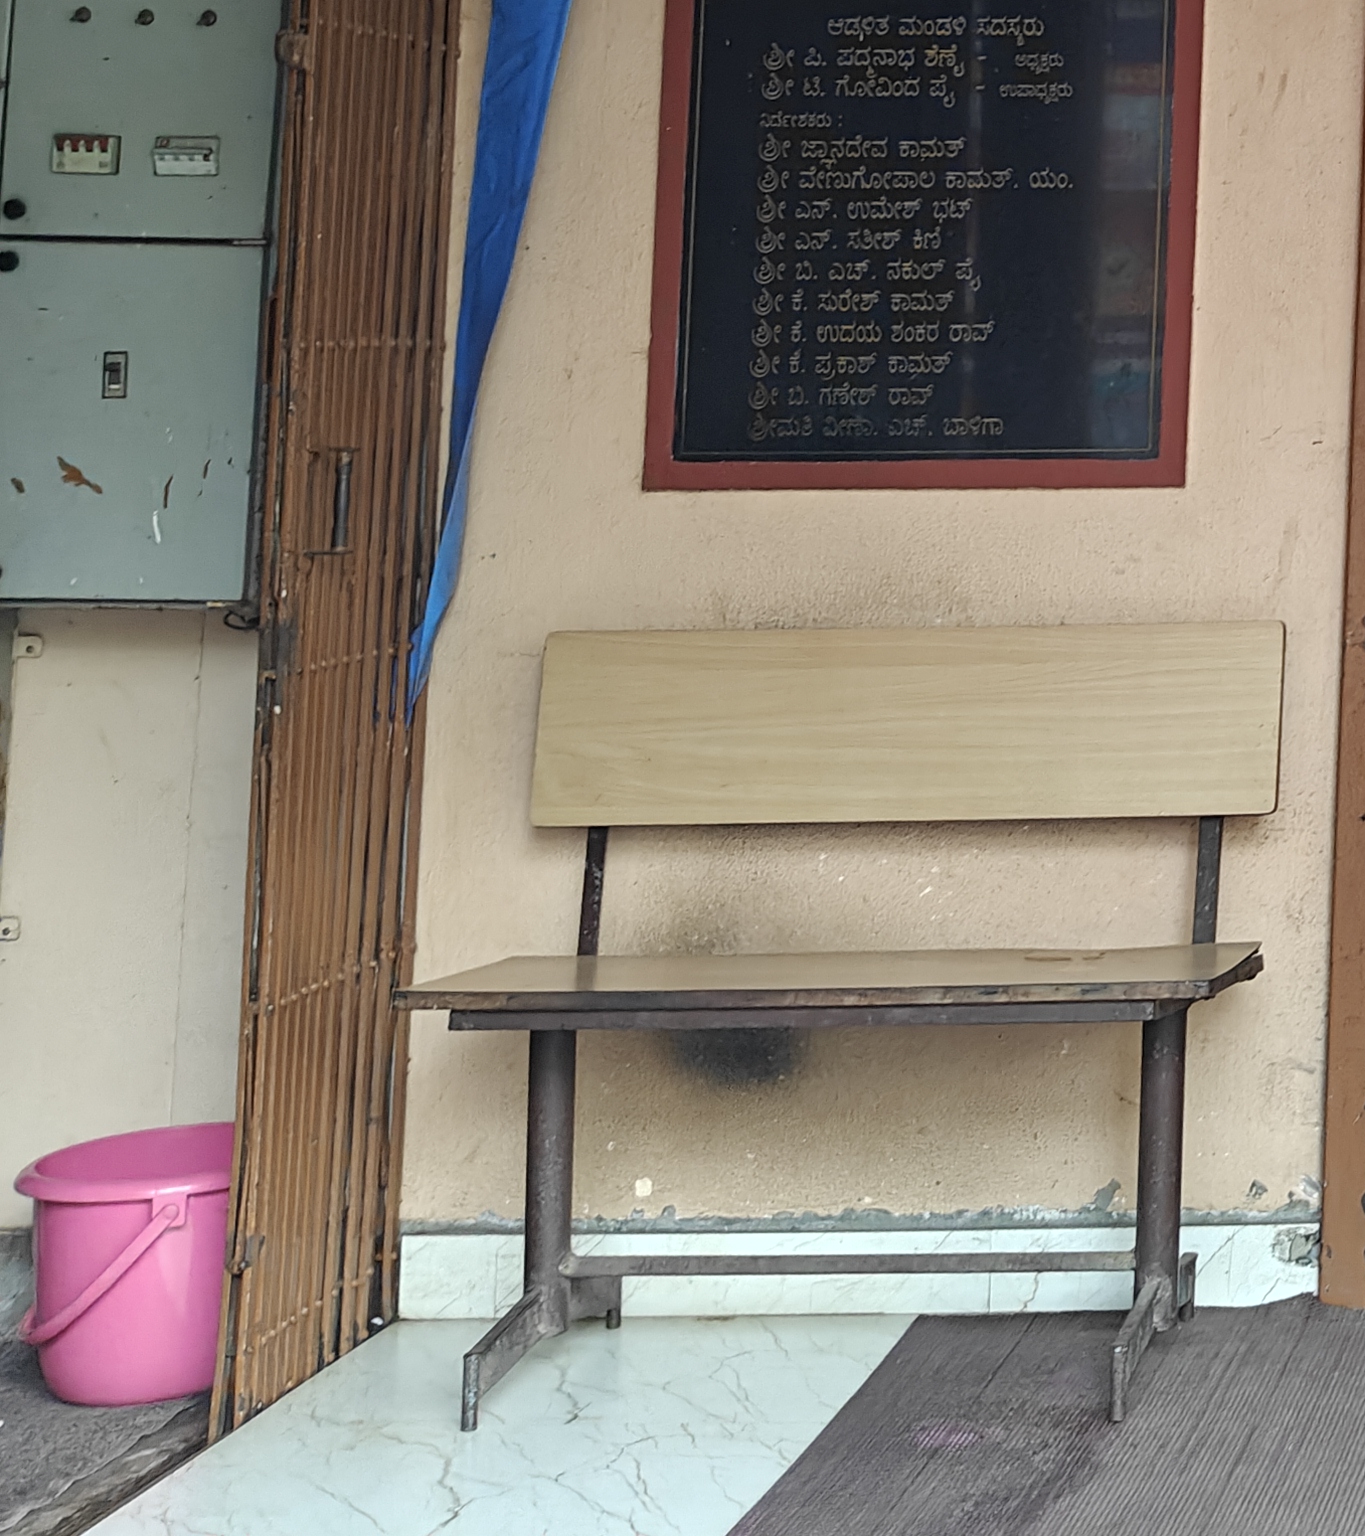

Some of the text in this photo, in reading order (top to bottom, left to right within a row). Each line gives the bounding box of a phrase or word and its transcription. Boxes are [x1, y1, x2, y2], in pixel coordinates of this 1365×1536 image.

[898, 14, 967, 37] ಮಂಡಳಿ
[976, 14, 1046, 47] ಸದಸ್ಯರು
[762, 42, 796, 72] ಶ್ರೀ
[836, 46, 916, 79] ಪದ್ಮನಾಭ
[761, 72, 795, 102] ಶ್ರೀ
[835, 74, 921, 98] ಗೋವಿಂದ
[758, 132, 792, 163] ಶ್ರೀ
[757, 164, 790, 193] ಶ್ರೀ
[798, 165, 936, 190] ವೇಣುಗೋಪಾಲ
[756, 194, 787, 224] ಶ್ರೀ
[847, 195, 923, 220] ಉಮೇಶ್
[931, 197, 975, 224] ಭಟ್
[755, 225, 787, 254] ಶ್ರೀ
[753, 256, 787, 285] ಶ್ರೀ
[752, 287, 784, 316] ಶ್ರೀ
[817, 287, 882, 312] ಸುರೇಶ್
[751, 318, 783, 348] ಶ್ರೀ
[815, 319, 883, 343] ಉದಯ
[889, 319, 940, 343] ಶಂಕರ
[948, 321, 997, 343] ರಾವ್
[748, 349, 781, 379] ಶ್ರೀ
[748, 380, 780, 410] ಶ್ರೀ
